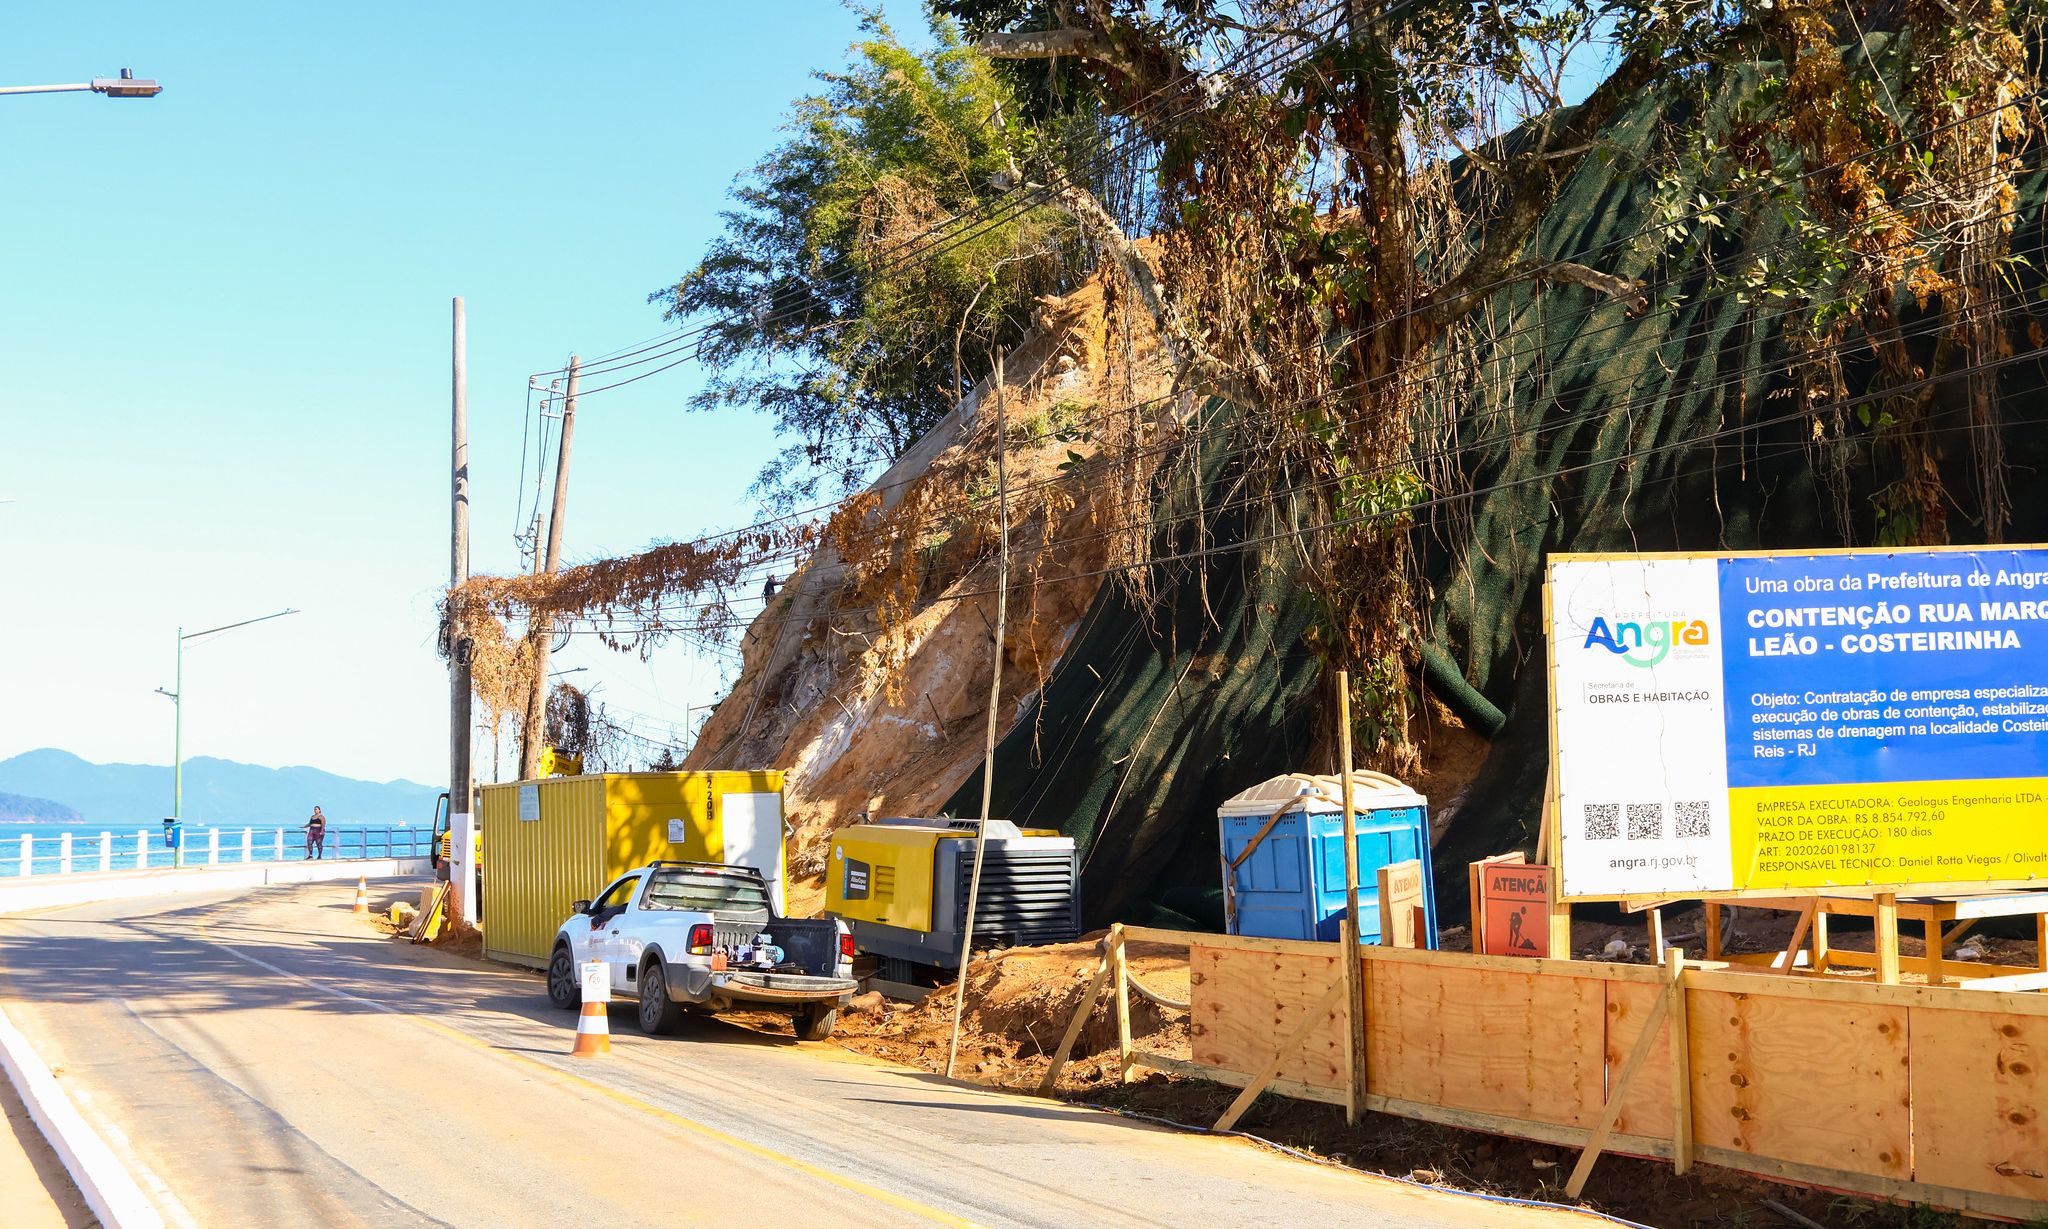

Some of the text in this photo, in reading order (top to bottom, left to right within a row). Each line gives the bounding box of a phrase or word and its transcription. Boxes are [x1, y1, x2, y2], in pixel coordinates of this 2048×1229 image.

[1745, 577, 1789, 594] Uma
[1793, 575, 1834, 592] obra
[1839, 574, 1862, 591] da
[1867, 572, 1962, 590] Prefeitura
[1967, 569, 1991, 587] de
[1747, 601, 1911, 630] CONTENÇÃO
[1919, 603, 1974, 623] RUA
[1583, 616, 1709, 668] Angra
[1749, 632, 1819, 657] LEÃO
[1841, 630, 2021, 654] COSTEIRINHA
[1626, 681, 1635, 689] de
[1589, 690, 1710, 704] OBRAS E HABITAÇÃO
[1751, 685, 2048, 709] Objeto: Contratação de empresa especializa
[1752, 709, 1818, 726] execução
[1820, 708, 1839, 721] de
[1841, 707, 1880, 721] obras
[1883, 706, 1901, 719] de
[1904, 704, 1979, 720] contenção,
[1752, 728, 1814, 741] sistemas
[1817, 725, 1835, 739] de
[1837, 725, 1906, 739] drenagem
[1909, 725, 1927, 736] na
[1930, 720, 1999, 735] localidade
[1753, 745, 1785, 759] Reis
[1797, 743, 1817, 757] RJ
[1757, 801, 1806, 813] EMPRESA
[1809, 797, 1895, 811] EXECUTADORA:
[1897, 795, 1949, 808] Geologus
[1952, 794, 2012, 807] Engenharia
[2015, 793, 2043, 804] LTDA
[1757, 816, 1794, 827] VALOR
[1797, 815, 1814, 826] DA
[1816, 814, 1851, 825] OBRA:
[1872, 811, 1945, 824] 8.854.792,60
[1758, 831, 1795, 842] PRAZO
[1799, 830, 1814, 841] DE
[1887, 826, 1908, 838] 180
[1910, 826, 1933, 837] dias
[1758, 843, 1876, 857] ART: 2020260198137
[1609, 854, 1698, 870] angra.rj.gov.br
[1899, 856, 1933, 867] Daniel
[1936, 855, 1963, 866] Rotta
[1966, 854, 2002, 867] Viegas
[1493, 875, 1547, 896] ATENÇÃ
